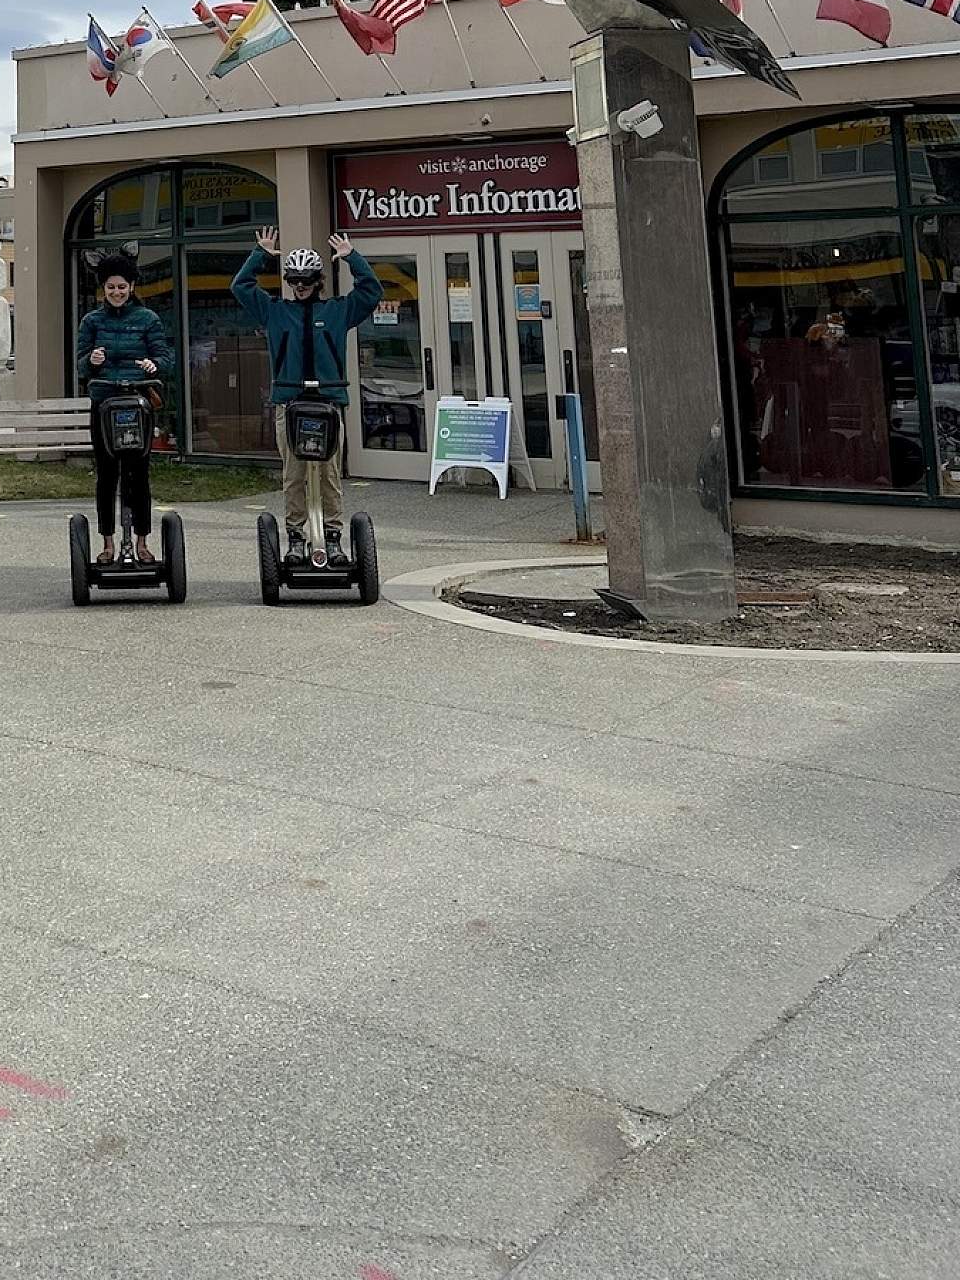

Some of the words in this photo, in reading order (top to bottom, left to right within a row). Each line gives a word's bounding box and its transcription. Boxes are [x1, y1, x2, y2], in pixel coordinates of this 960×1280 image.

[418, 161, 449, 175] visit
[467, 154, 546, 173] anchorage
[343, 188, 440, 220] Visitor
